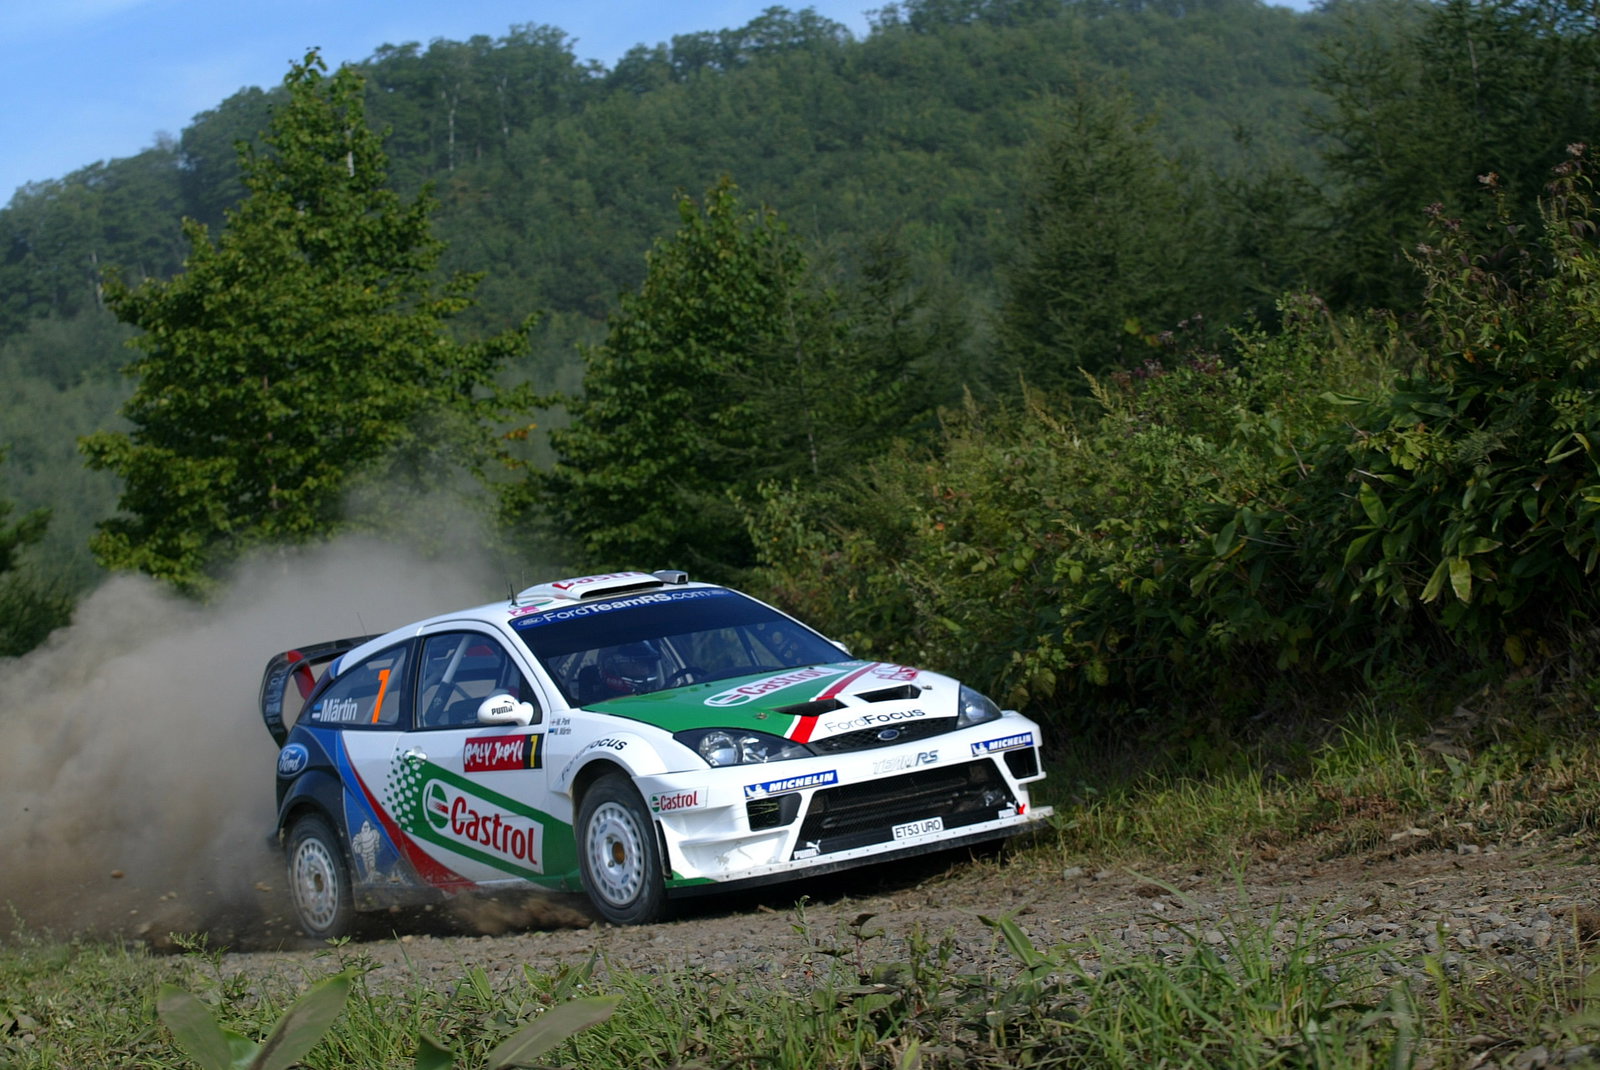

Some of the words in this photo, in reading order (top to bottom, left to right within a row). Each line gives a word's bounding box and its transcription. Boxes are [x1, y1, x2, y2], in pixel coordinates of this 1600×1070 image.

[543, 590, 709, 622] FordTeamRS.com
[737, 669, 832, 695] Castrol
[371, 669, 391, 724] 1
[320, 698, 358, 722] Märtin
[530, 735, 538, 768] 1
[988, 734, 1032, 751] MICHELIN
[279, 749, 300, 772] Ford
[768, 772, 836, 792] MICHELIN
[660, 791, 698, 811] Castrol
[451, 796, 538, 865] Castrol
[895, 824, 919, 838] ET53
[921, 819, 941, 833] URO
